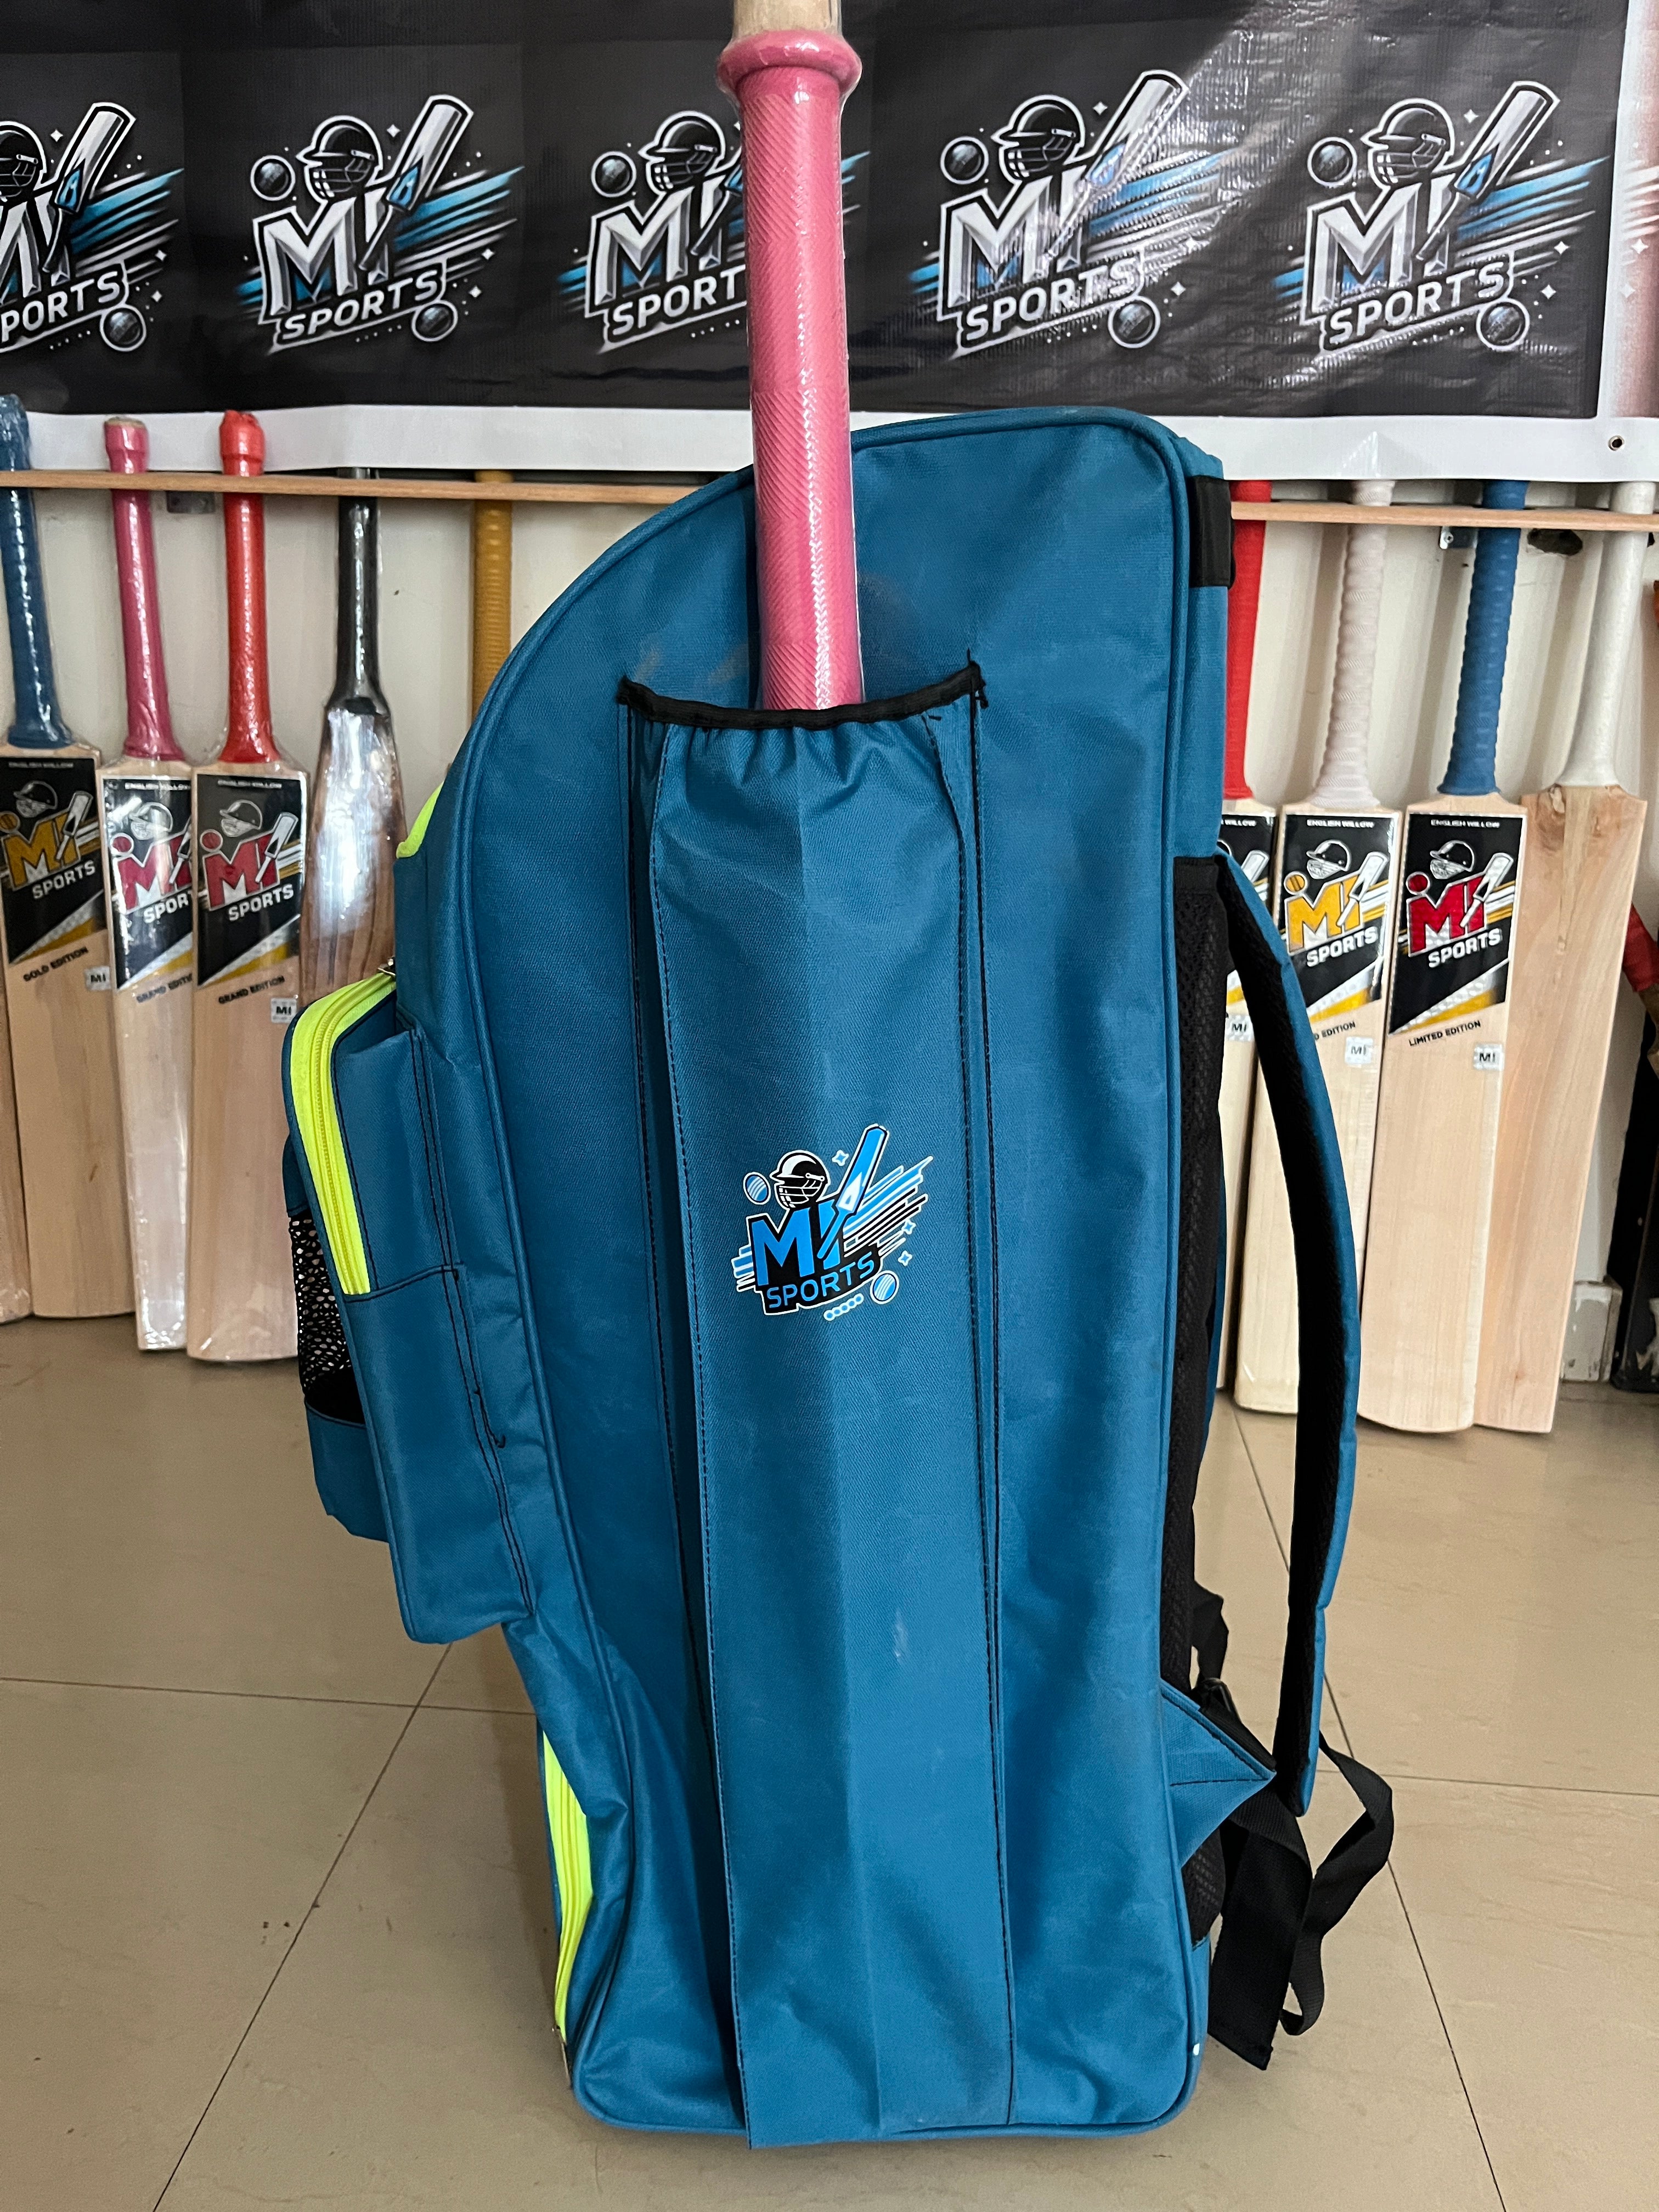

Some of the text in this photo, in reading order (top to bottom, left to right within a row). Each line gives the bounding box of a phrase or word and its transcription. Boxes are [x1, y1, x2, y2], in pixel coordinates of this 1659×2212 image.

[264, 187, 388, 317] MI
[595, 175, 721, 306] MI
[947, 165, 1085, 308] MI
[1311, 173, 1457, 313] MI
[1, 270, 120, 343] PORTS
[281, 270, 438, 340] SPORTS
[612, 263, 746, 335] SPORT
[965, 255, 1138, 341] SPORTS
[1329, 261, 1505, 345] SPORTS
[4, 812, 79, 888] MI
[32, 860, 95, 899] SPORTS
[116, 833, 192, 912] MI
[204, 832, 279, 909] MI
[144, 890, 192, 923] SPOR
[228, 883, 294, 922] SPORTS
[1285, 874, 1362, 954] MI
[1407, 874, 1487, 956] MI
[91, 973, 106, 983] MI
[1307, 926, 1379, 967] SPORTS
[1428, 928, 1503, 968] SPORTS
[276, 1006, 291, 1015] MI
[1231, 1023, 1247, 1032] MI
[1322, 1020, 1356, 1038] EDITION
[1409, 1020, 1481, 1046] LIMITED EDITION
[1351, 1045, 1366, 1055] MI
[1479, 1052, 1496, 1062] MI
[751, 1199, 840, 1286] MI
[766, 1251, 874, 1308] SPORTS
